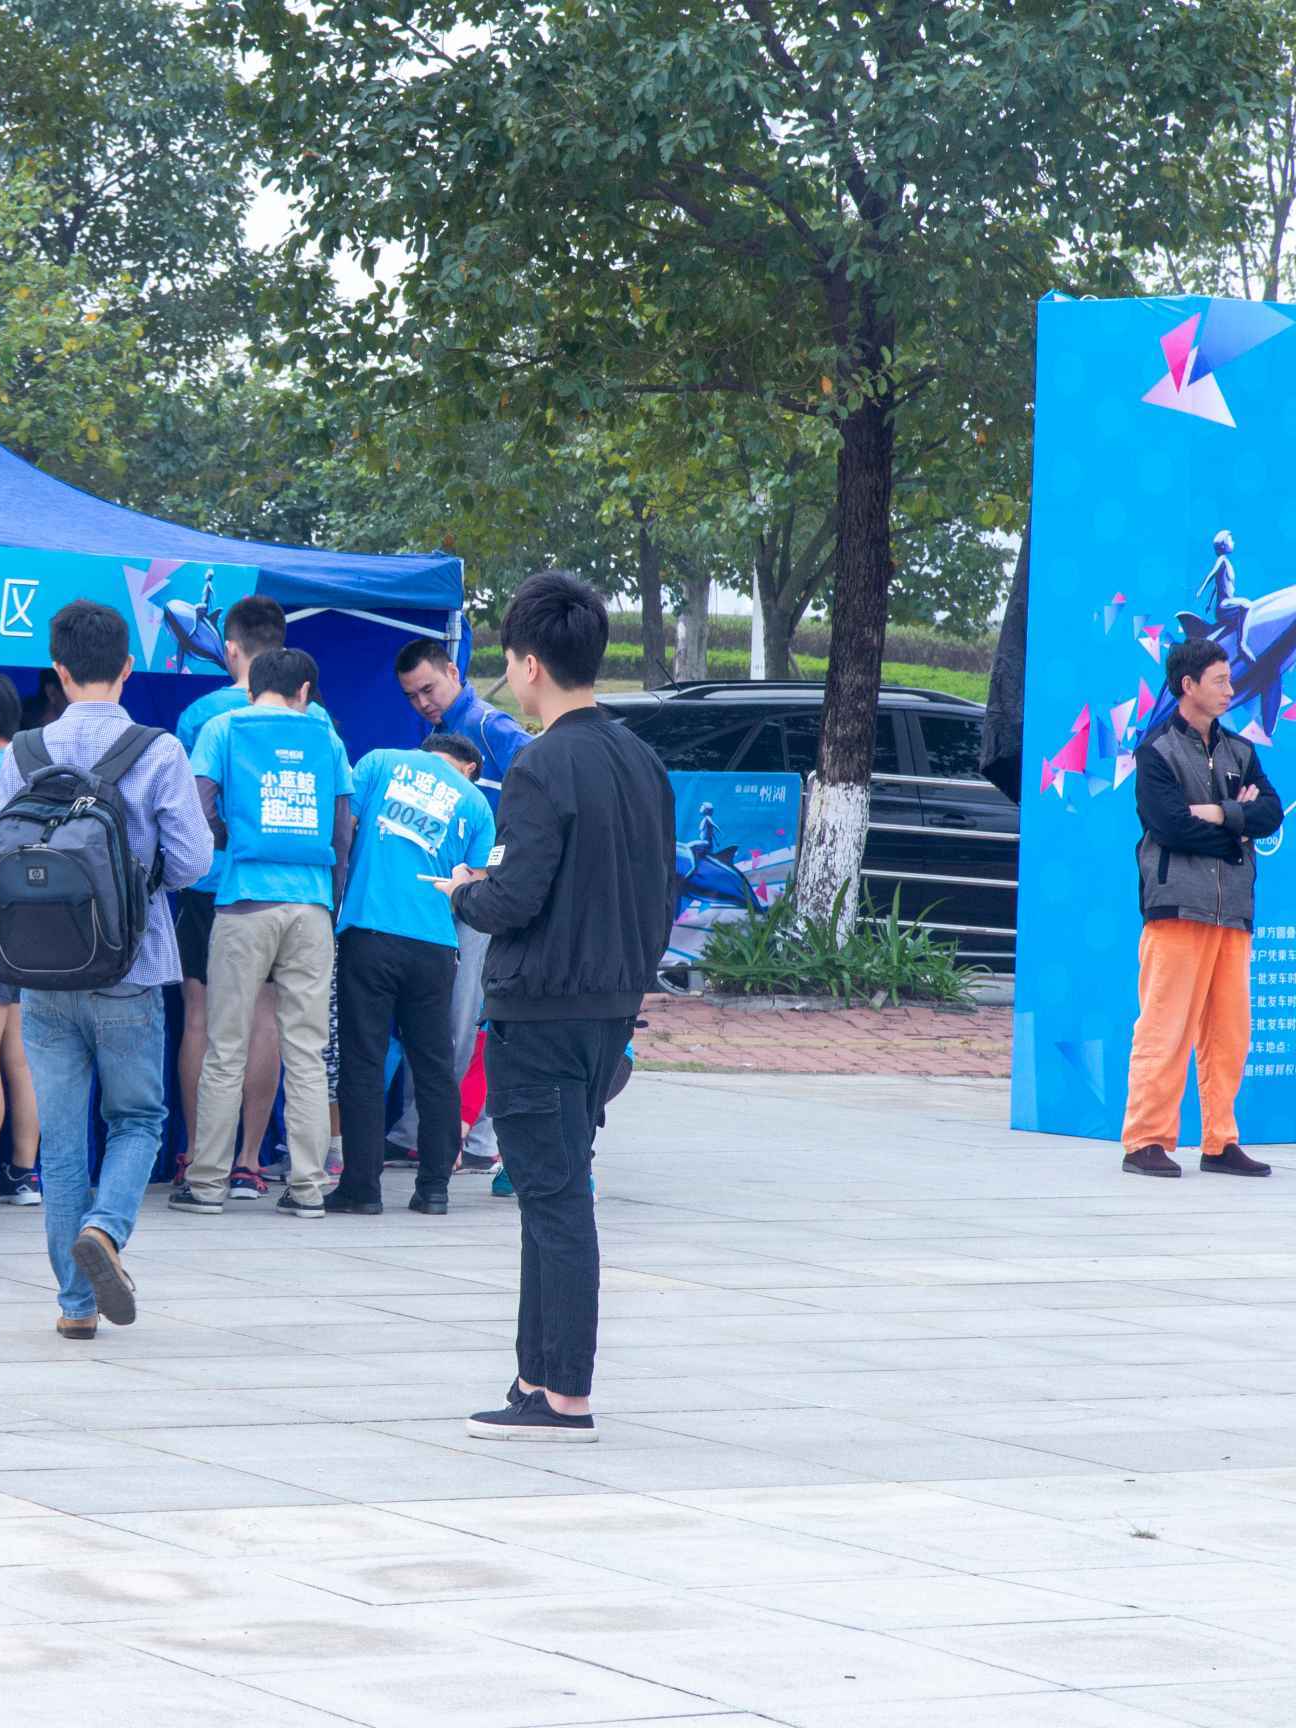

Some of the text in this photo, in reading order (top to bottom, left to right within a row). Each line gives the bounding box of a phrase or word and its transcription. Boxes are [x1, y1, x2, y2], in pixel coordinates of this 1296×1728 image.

[261, 770, 317, 794] 小蓝鲸
[260, 787, 317, 807] RUN FUN
[386, 801, 442, 841] 0042
[1244, 1064, 1296, 1078] 最终解释权
